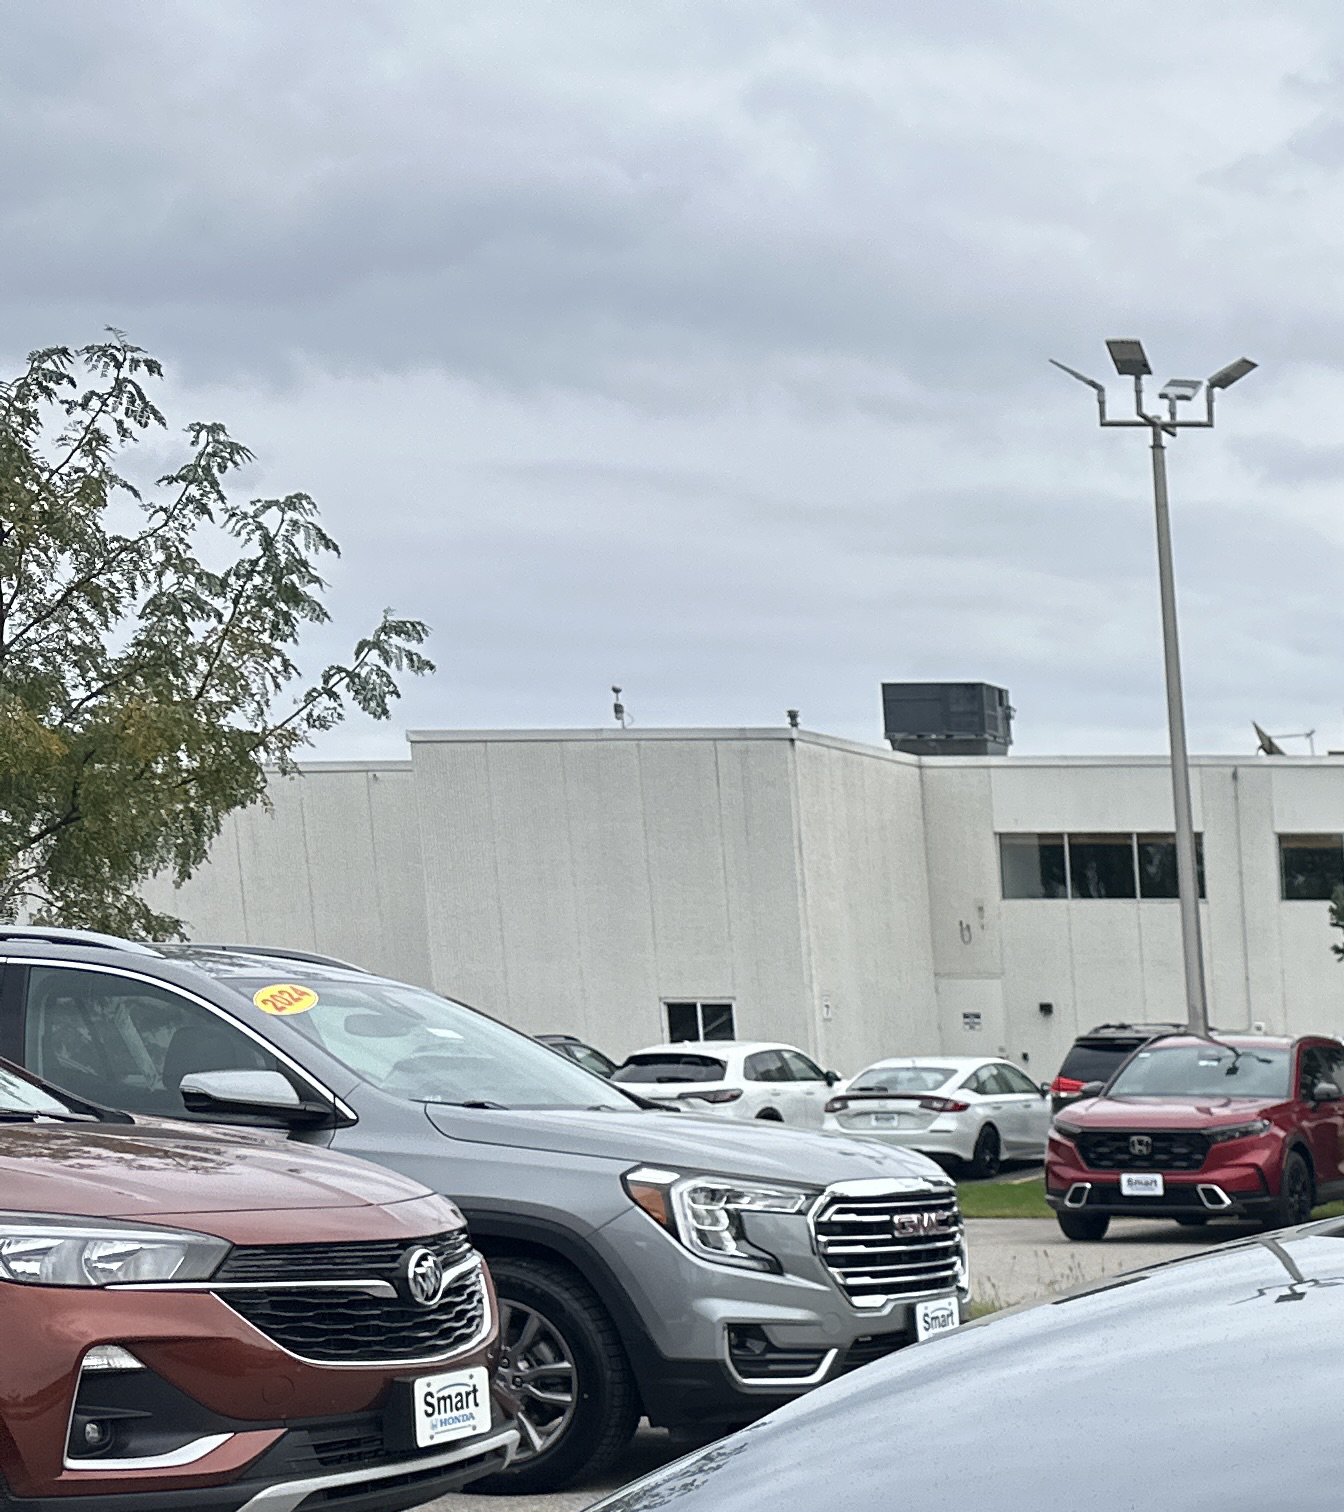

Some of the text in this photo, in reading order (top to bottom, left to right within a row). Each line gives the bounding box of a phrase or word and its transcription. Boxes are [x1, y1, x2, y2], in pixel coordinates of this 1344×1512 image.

[893, 1209, 957, 1238] GMC
[922, 1310, 955, 1331] Smart
[423, 1383, 479, 1418] Smart
[439, 1412, 475, 1428] HONDA
